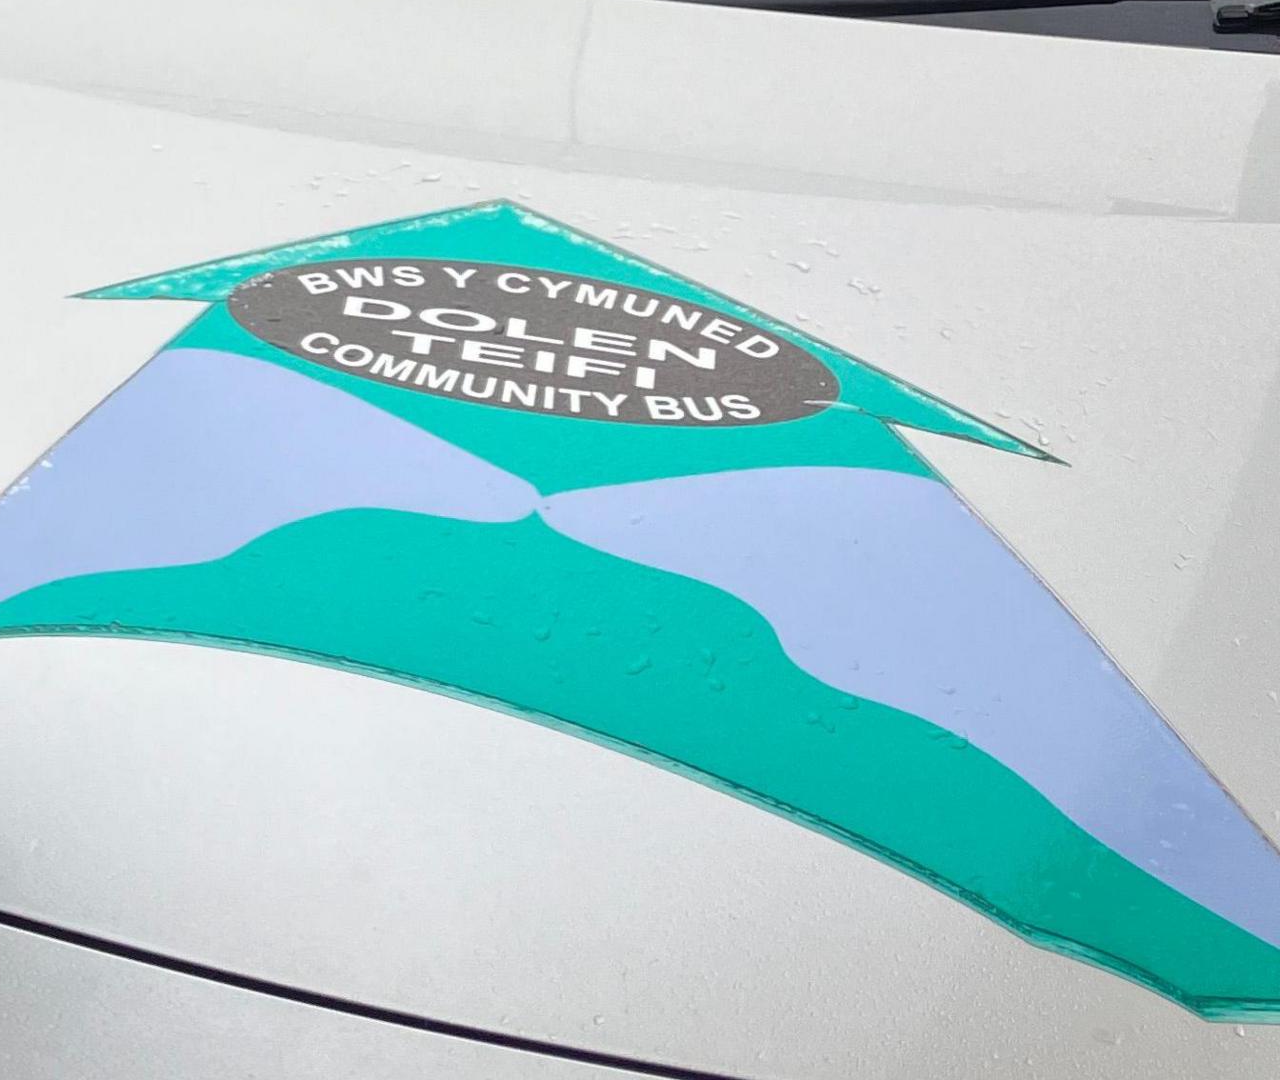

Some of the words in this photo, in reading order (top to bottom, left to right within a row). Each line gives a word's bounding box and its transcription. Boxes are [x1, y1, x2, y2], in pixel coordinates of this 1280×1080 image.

[298, 265, 425, 295] BWS
[443, 267, 477, 289] Y
[496, 272, 780, 360] CYMUNED
[343, 295, 717, 370] DOLEN
[299, 332, 628, 417] COMMUNITY
[646, 394, 762, 421] BUS
[392, 330, 656, 389] TEIFI
